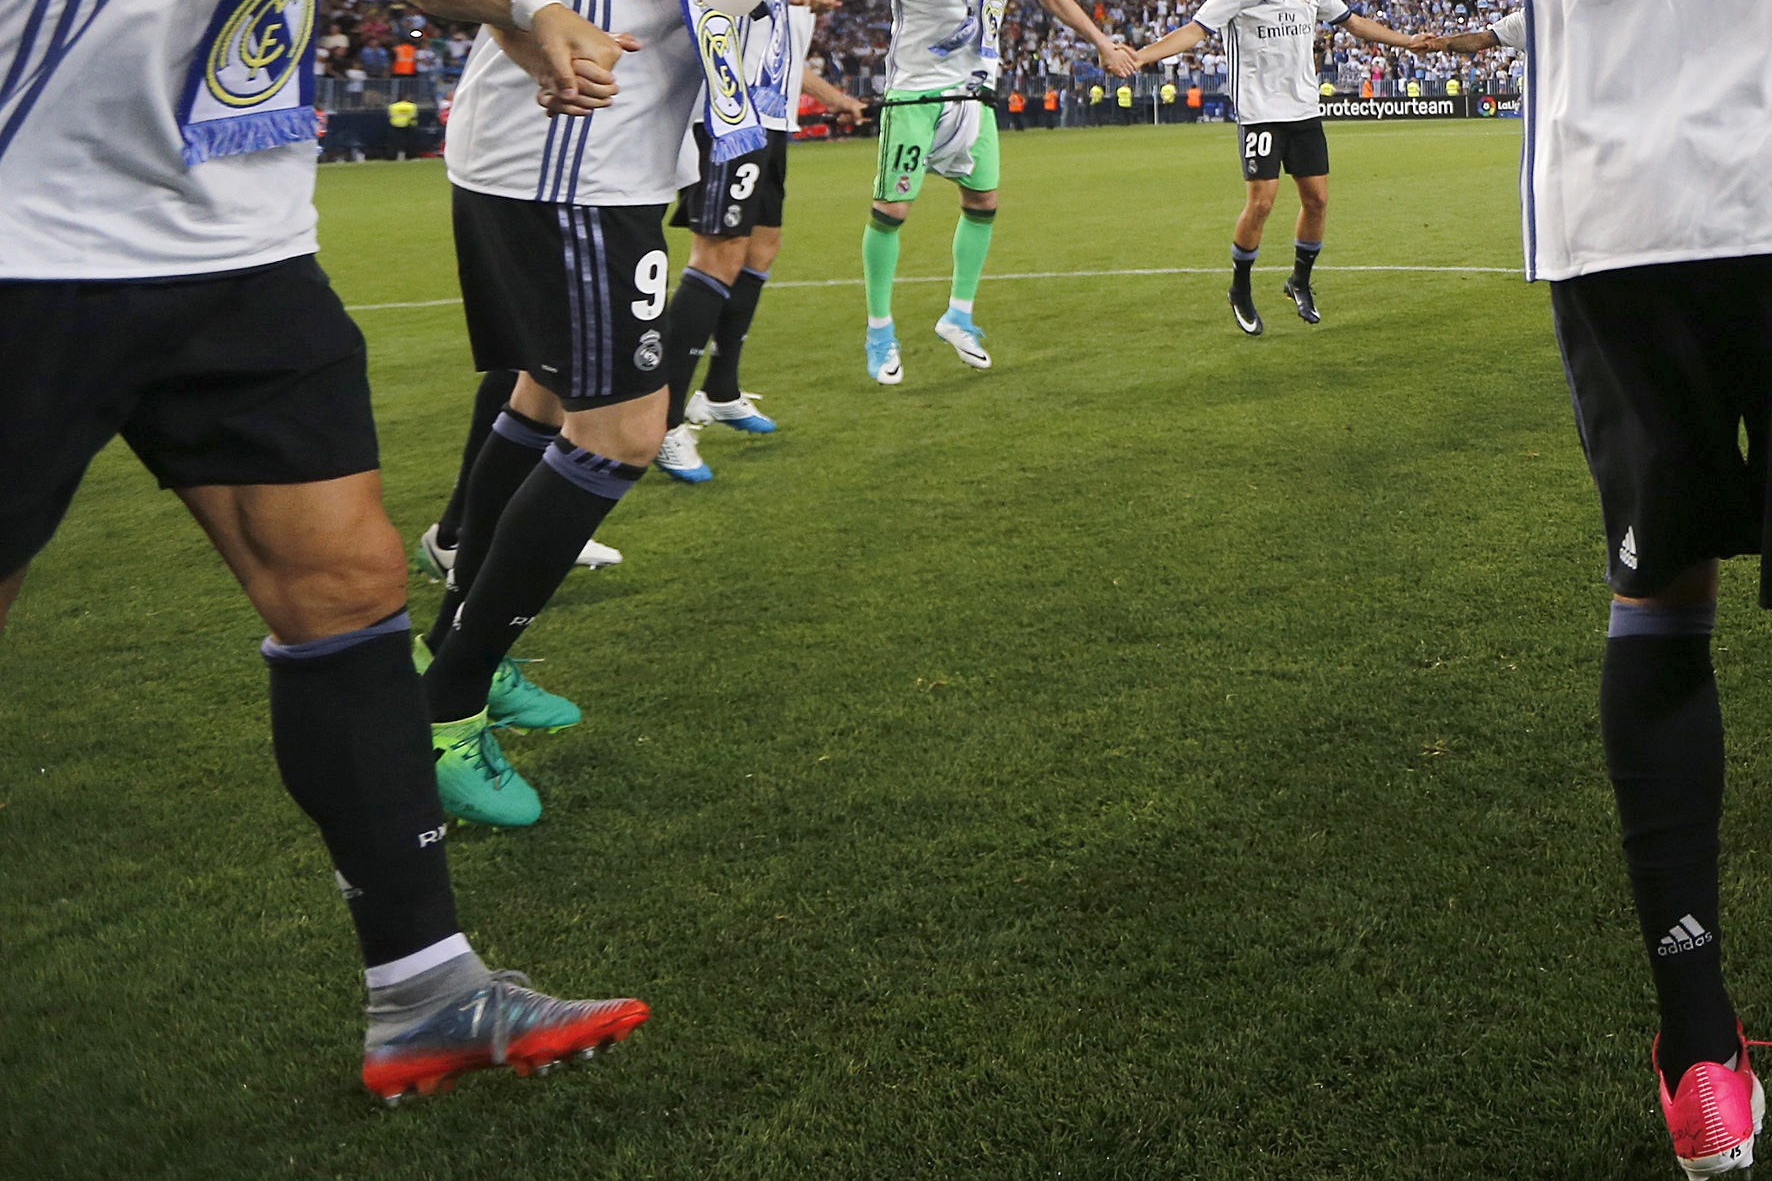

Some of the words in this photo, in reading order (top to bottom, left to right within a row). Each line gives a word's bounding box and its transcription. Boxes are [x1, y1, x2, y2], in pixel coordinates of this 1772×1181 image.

[1257, 23, 1312, 39] Emirates
[1278, 12, 1295, 23] Fly
[892, 145, 921, 173] 13
[1245, 131, 1273, 159] 20
[729, 163, 760, 201] 3
[631, 249, 669, 321] 9
[1657, 931, 1713, 957] adidas
